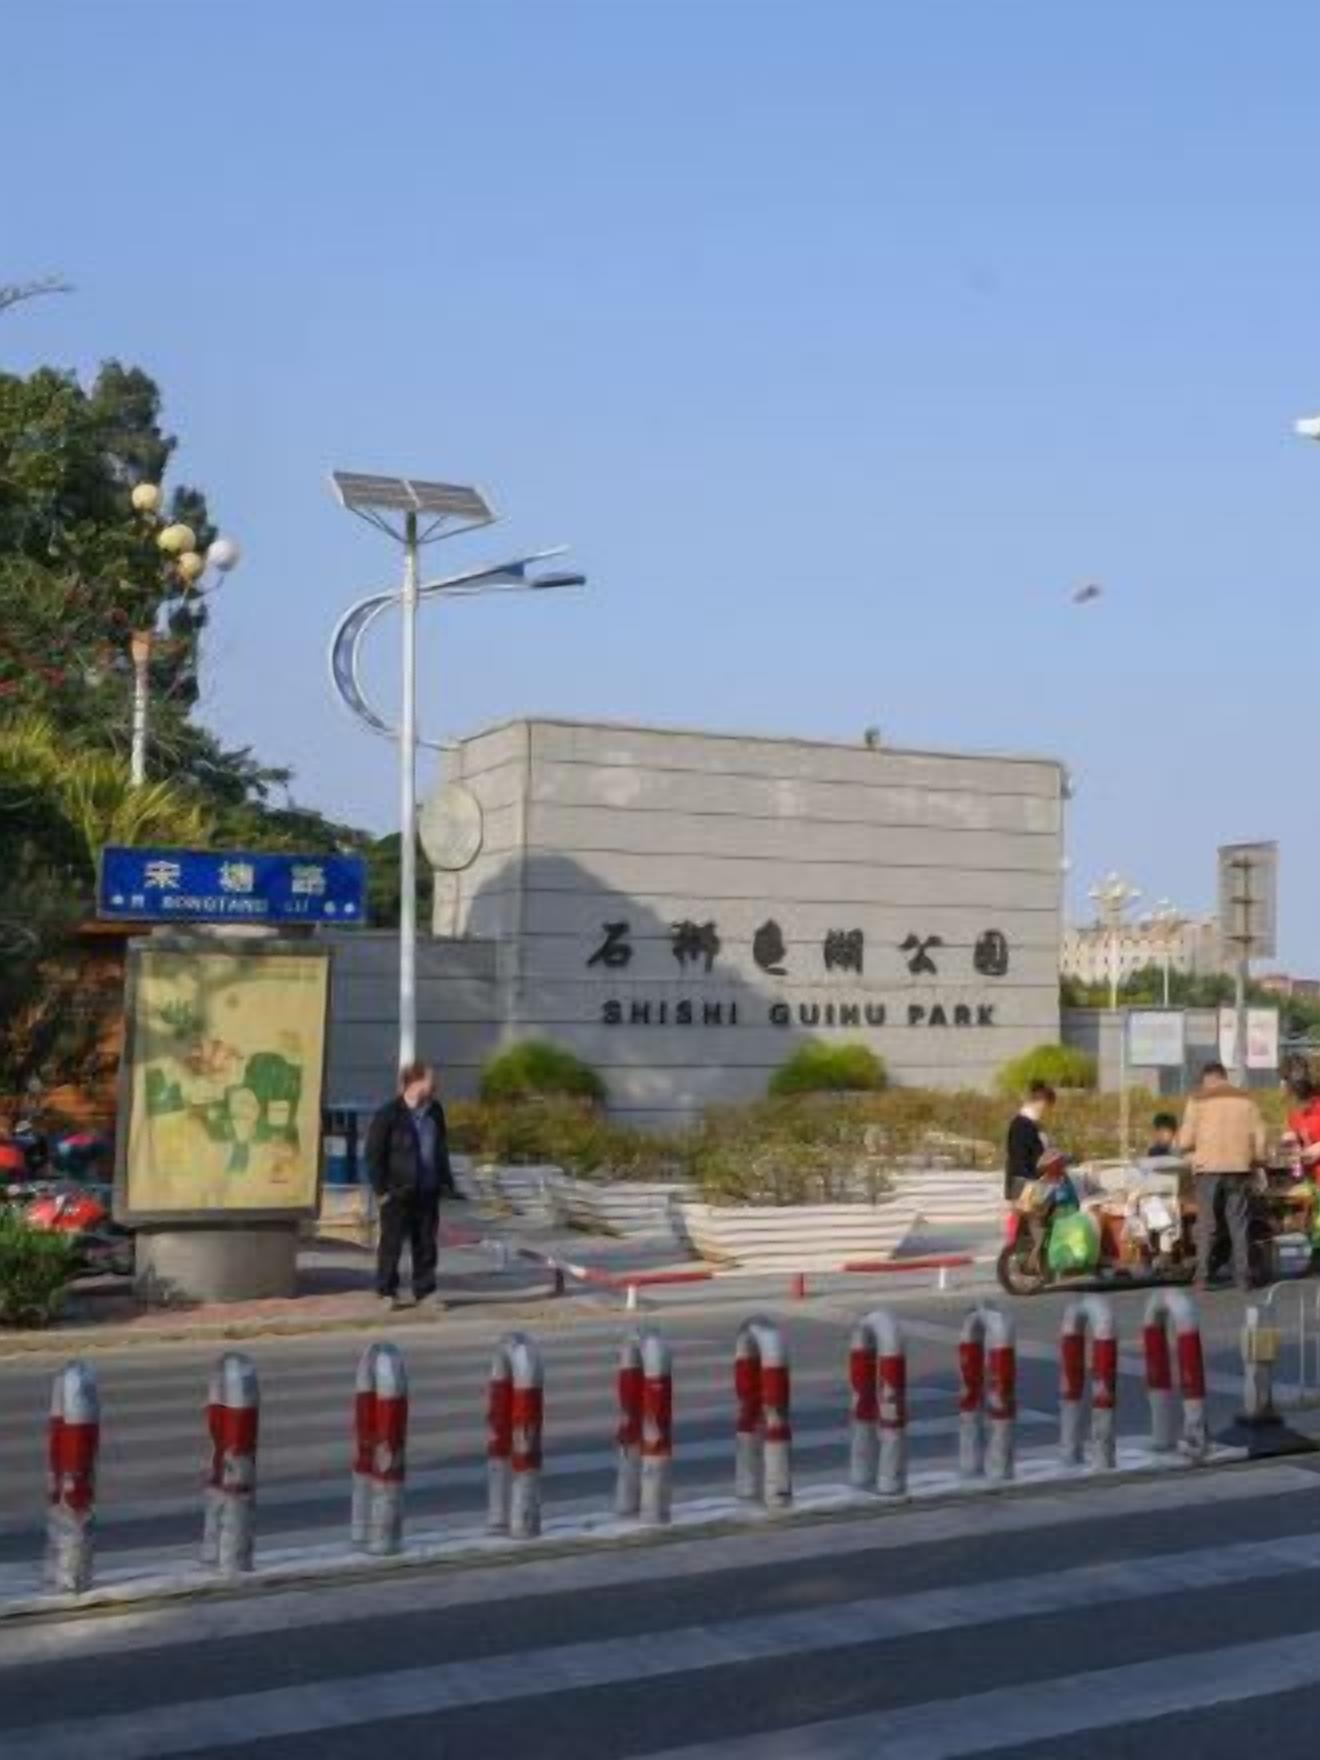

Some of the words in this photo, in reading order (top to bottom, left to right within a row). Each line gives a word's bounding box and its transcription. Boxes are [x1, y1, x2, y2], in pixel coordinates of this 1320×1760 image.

[602, 1000, 737, 1025] SHISHI
[769, 1003, 886, 1026] GUIHU
[907, 1003, 994, 1026] PARK
